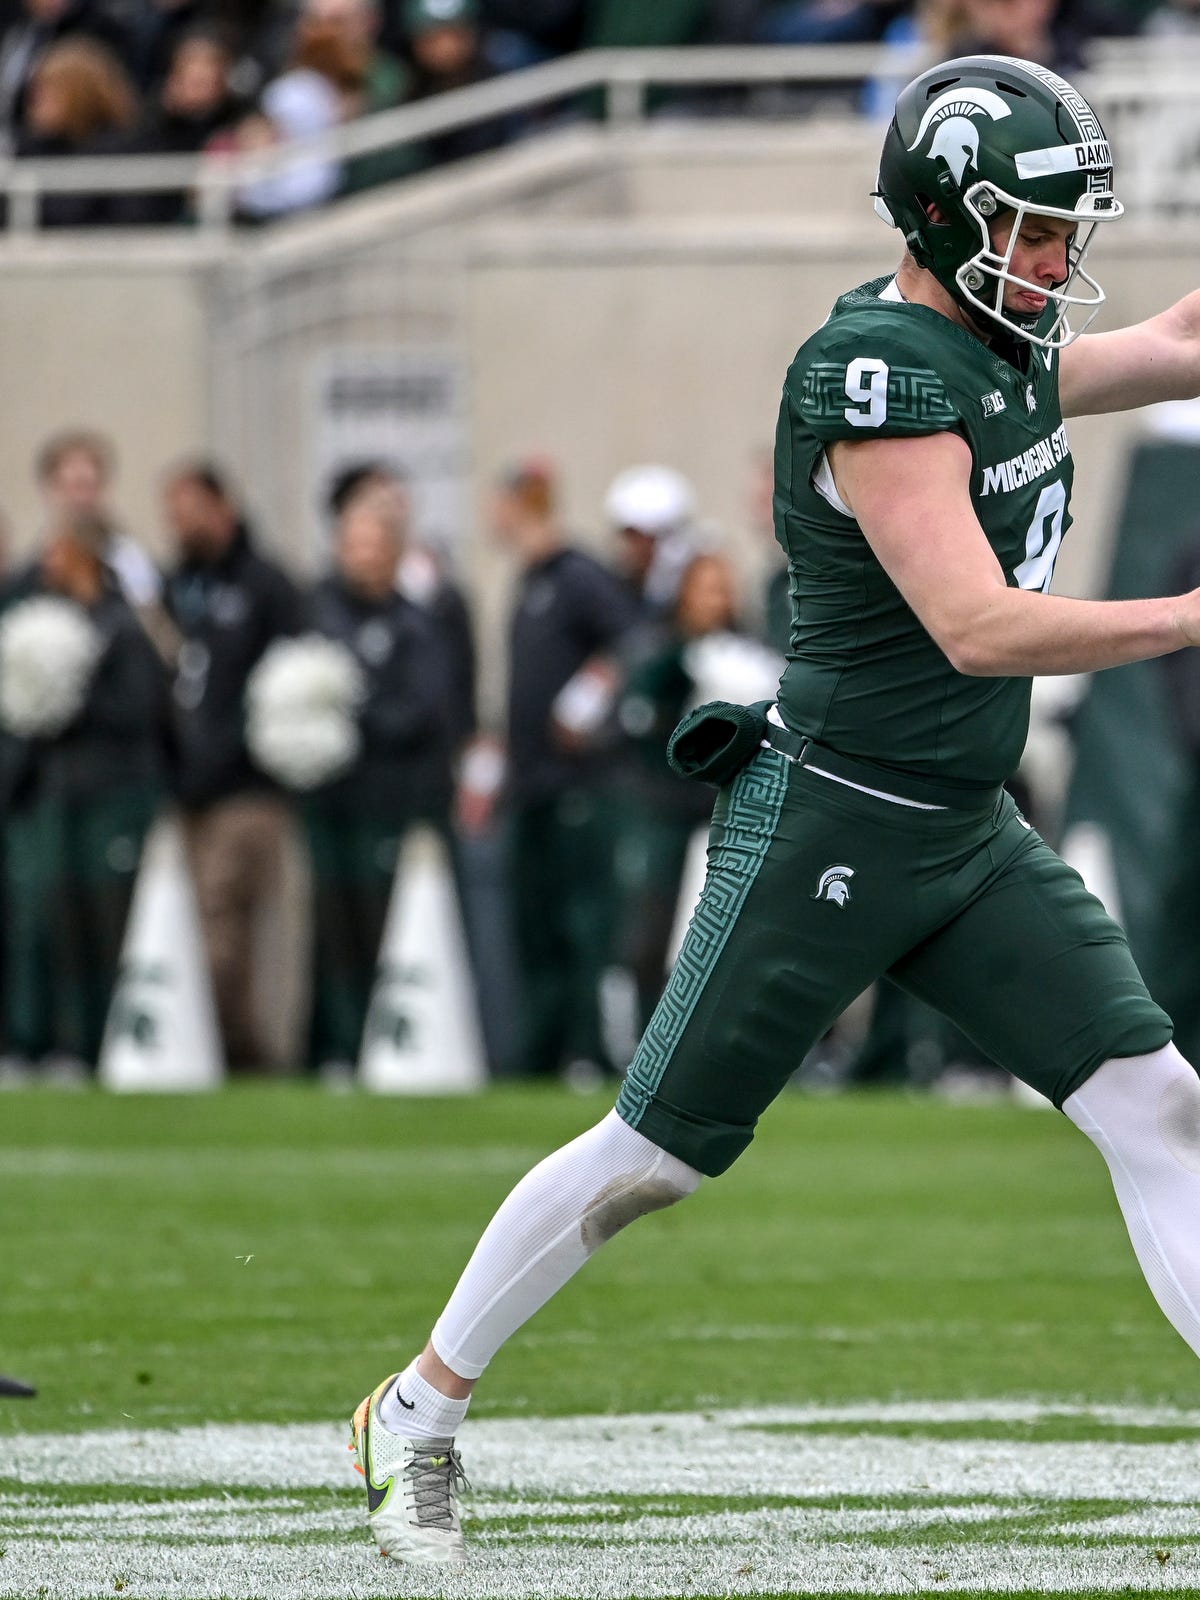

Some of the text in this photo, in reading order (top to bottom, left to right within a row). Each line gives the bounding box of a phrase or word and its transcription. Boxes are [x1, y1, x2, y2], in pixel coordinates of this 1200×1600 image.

[1075, 143, 1111, 167] DAKIN
[844, 357, 889, 428] 9
[979, 422, 1069, 497] MICHIGAN STA
[1013, 478, 1066, 594] 9
